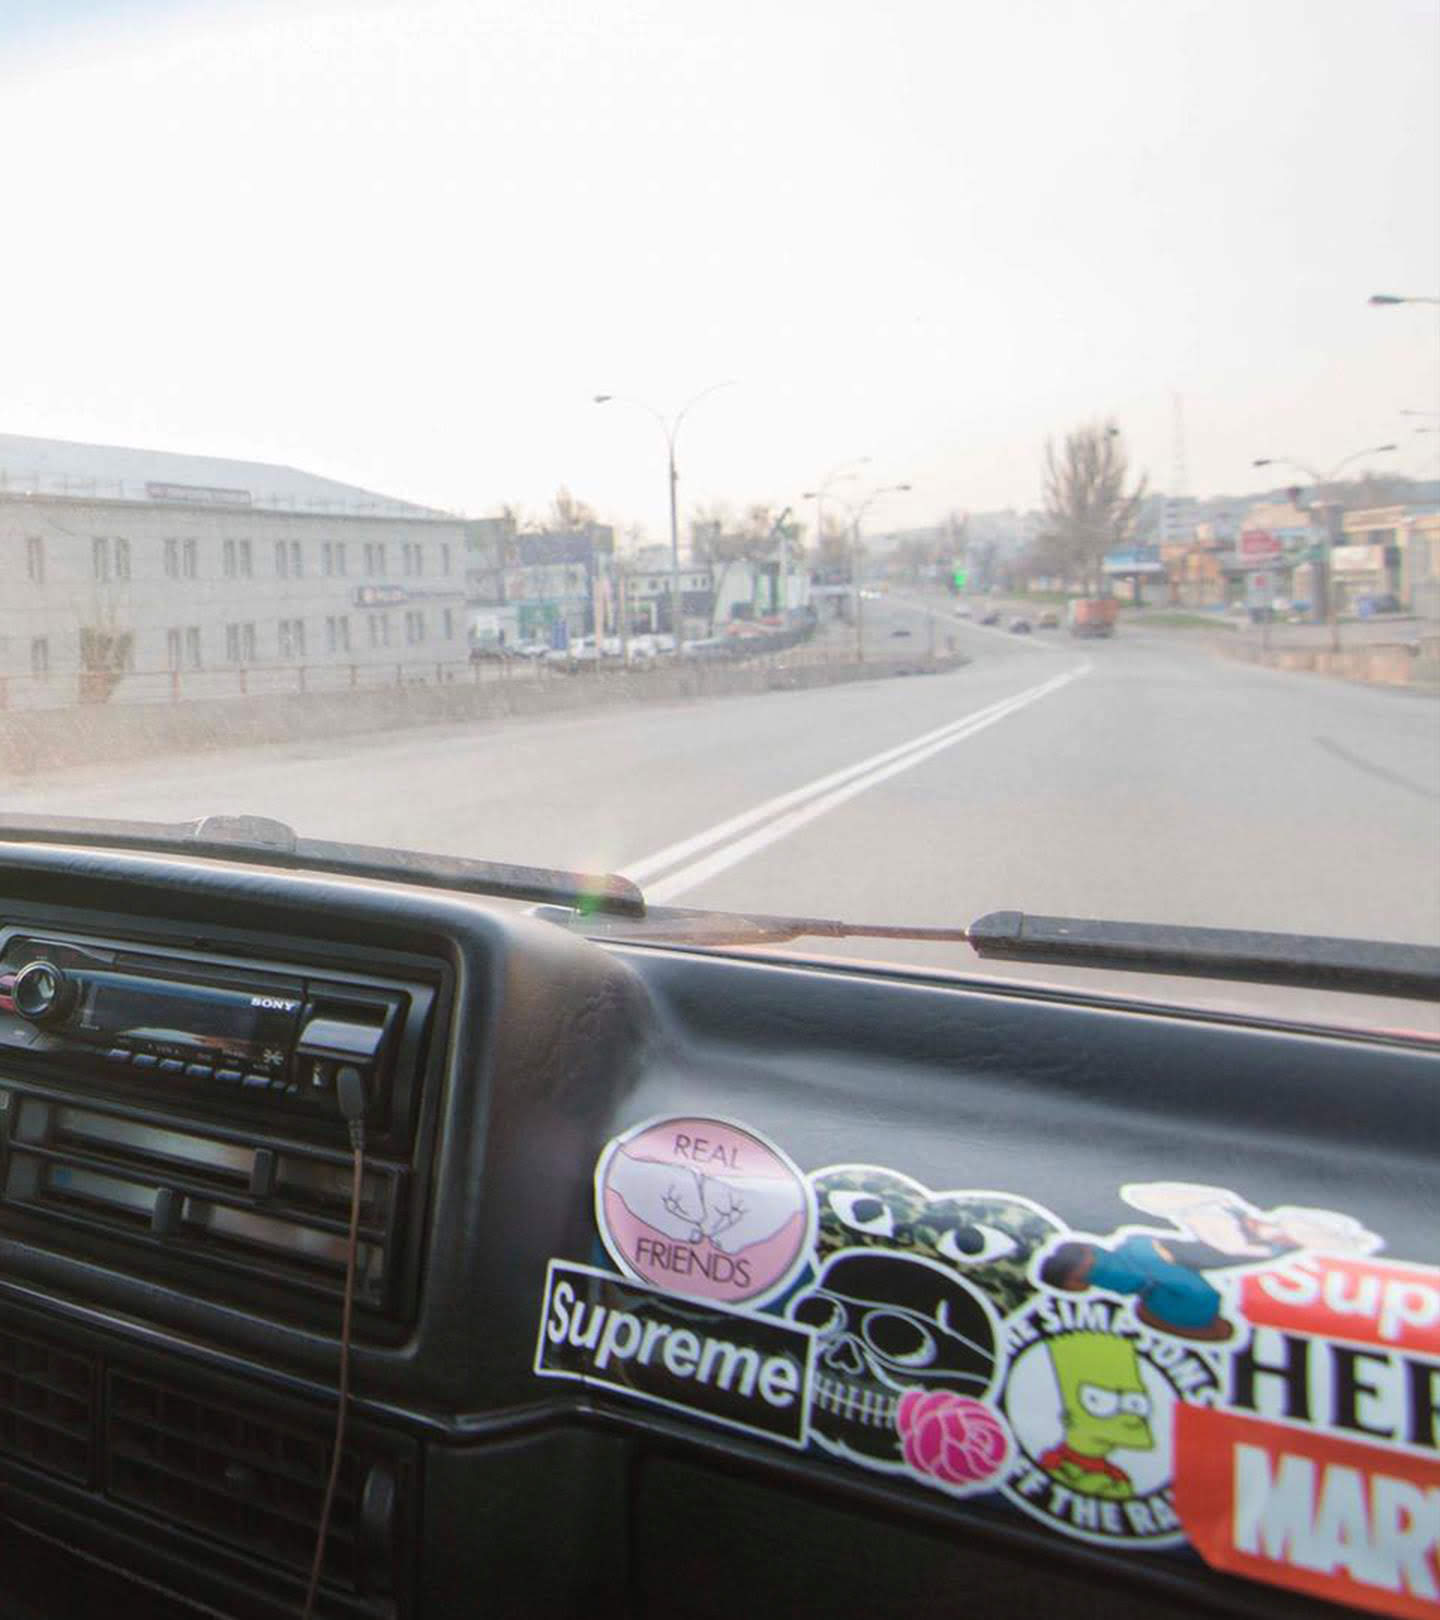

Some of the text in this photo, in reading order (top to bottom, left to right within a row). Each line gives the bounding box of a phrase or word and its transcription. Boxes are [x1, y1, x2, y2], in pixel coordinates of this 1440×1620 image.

[250, 997, 296, 1012] SONY
[673, 1133, 744, 1170] REAL
[634, 1237, 753, 1289] FRIENDS
[1257, 1258, 1440, 1342] Sup
[546, 1280, 801, 1408] Supreme
[1232, 1442, 1440, 1608] MAR
